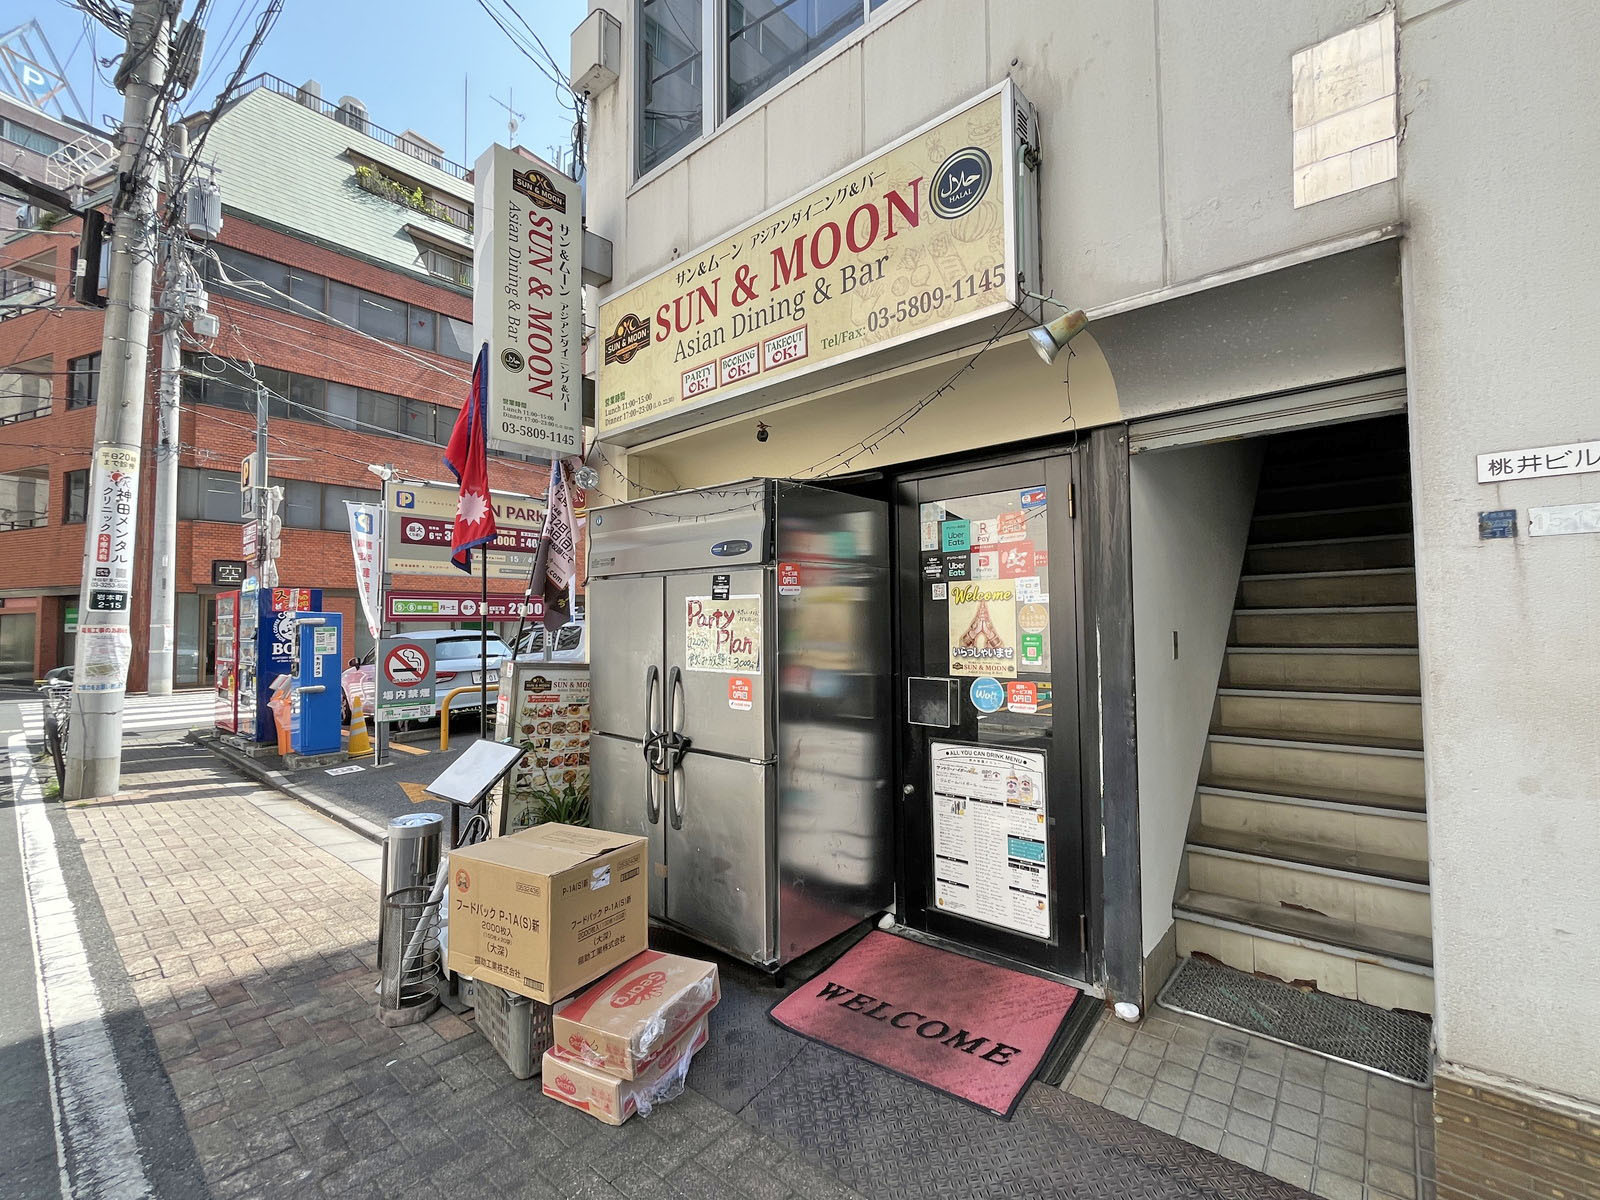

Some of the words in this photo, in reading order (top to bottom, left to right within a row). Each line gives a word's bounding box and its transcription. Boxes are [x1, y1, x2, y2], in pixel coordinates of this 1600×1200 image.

[517, 178, 533, 190] SUN
[949, 188, 973, 204] HALAL
[508, 200, 522, 246] Asian
[528, 210, 553, 275] SUN
[656, 276, 722, 344] SUN
[732, 264, 760, 307] &
[770, 176, 924, 292] MOON
[676, 244, 744, 286] サン&ムーン
[504, 250, 522, 298] Dining
[528, 278, 553, 299] &
[674, 326, 728, 364] Asian
[732, 289, 806, 338] Dining
[814, 277, 834, 305] &
[840, 254, 890, 297] Bar
[820, 326, 866, 350] Tel/Fax:
[867, 264, 1006, 333] 03-5809-1145
[508, 316, 521, 342] Bar
[608, 340, 621, 354] SUN
[628, 328, 646, 344] MOON
[766, 331, 804, 354] TAKEOUT
[528, 305, 553, 400] MOON
[722, 350, 756, 371] BOOKING
[772, 344, 798, 364] OK!
[685, 366, 713, 384] PARTY
[728, 362, 752, 380] OK!
[688, 376, 709, 394] OK!
[503, 406, 522, 414] Lunch
[503, 412, 523, 420] Dinner
[605, 404, 621, 417] Lunch
[605, 415, 622, 426] Dinner
[502, 422, 574, 445] 03-5809-1145
[1488, 448, 1600, 476] 桃井ビル
[100, 487, 113, 532] クリニック
[112, 489, 132, 563] 神田メンタル
[218, 565, 242, 582] 空
[951, 584, 1012, 604] Welcome
[688, 600, 735, 629] Party
[716, 630, 752, 655] Plan
[953, 647, 1013, 658] いらっしゃいませ
[1005, 756, 1022, 764] MENU
[482, 921, 513, 938] 2000枚入
[487, 941, 508, 958] (大深)
[474, 956, 521, 978] 福助工業株式会社
[614, 972, 662, 1006] Seara
[816, 982, 1022, 1066] WELCOME
